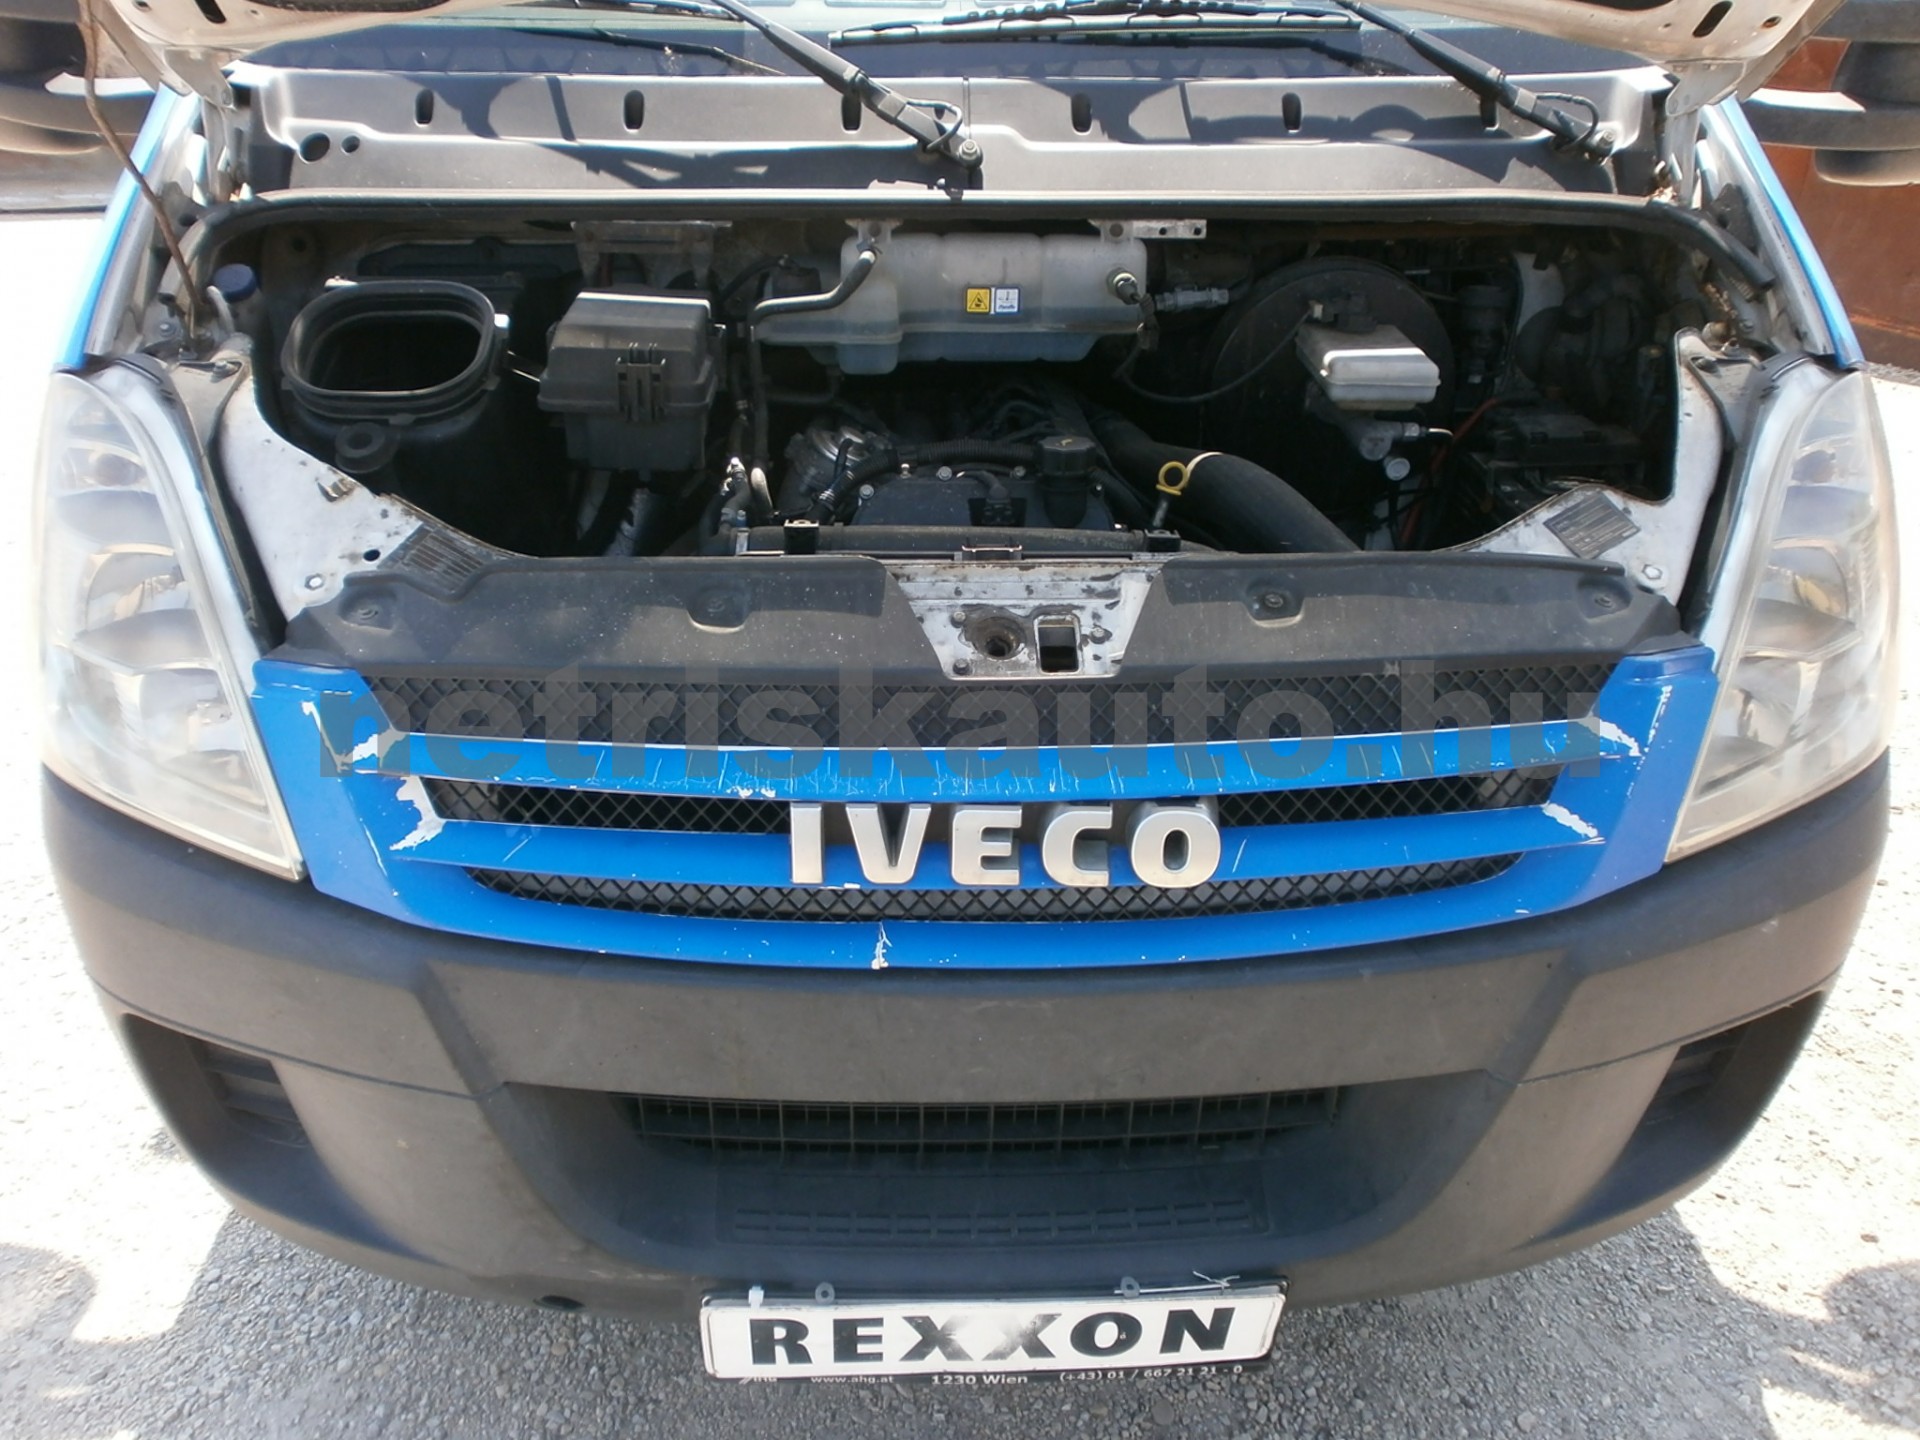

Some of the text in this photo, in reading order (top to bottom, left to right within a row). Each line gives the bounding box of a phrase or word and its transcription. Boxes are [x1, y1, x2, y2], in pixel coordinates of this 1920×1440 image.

[789, 801, 1222, 888] IVECO
[748, 1306, 1237, 1365] REXXON
[810, 1375, 895, 1384] www.ahg.at
[931, 1374, 1029, 1385] 1230 Wien
[1059, 1370, 1103, 1382] (+43)
[1106, 1370, 1125, 1380] 01
[1143, 1368, 1172, 1378] 667
[1176, 1367, 1194, 1377] 21
[1200, 1365, 1217, 1375] 21
